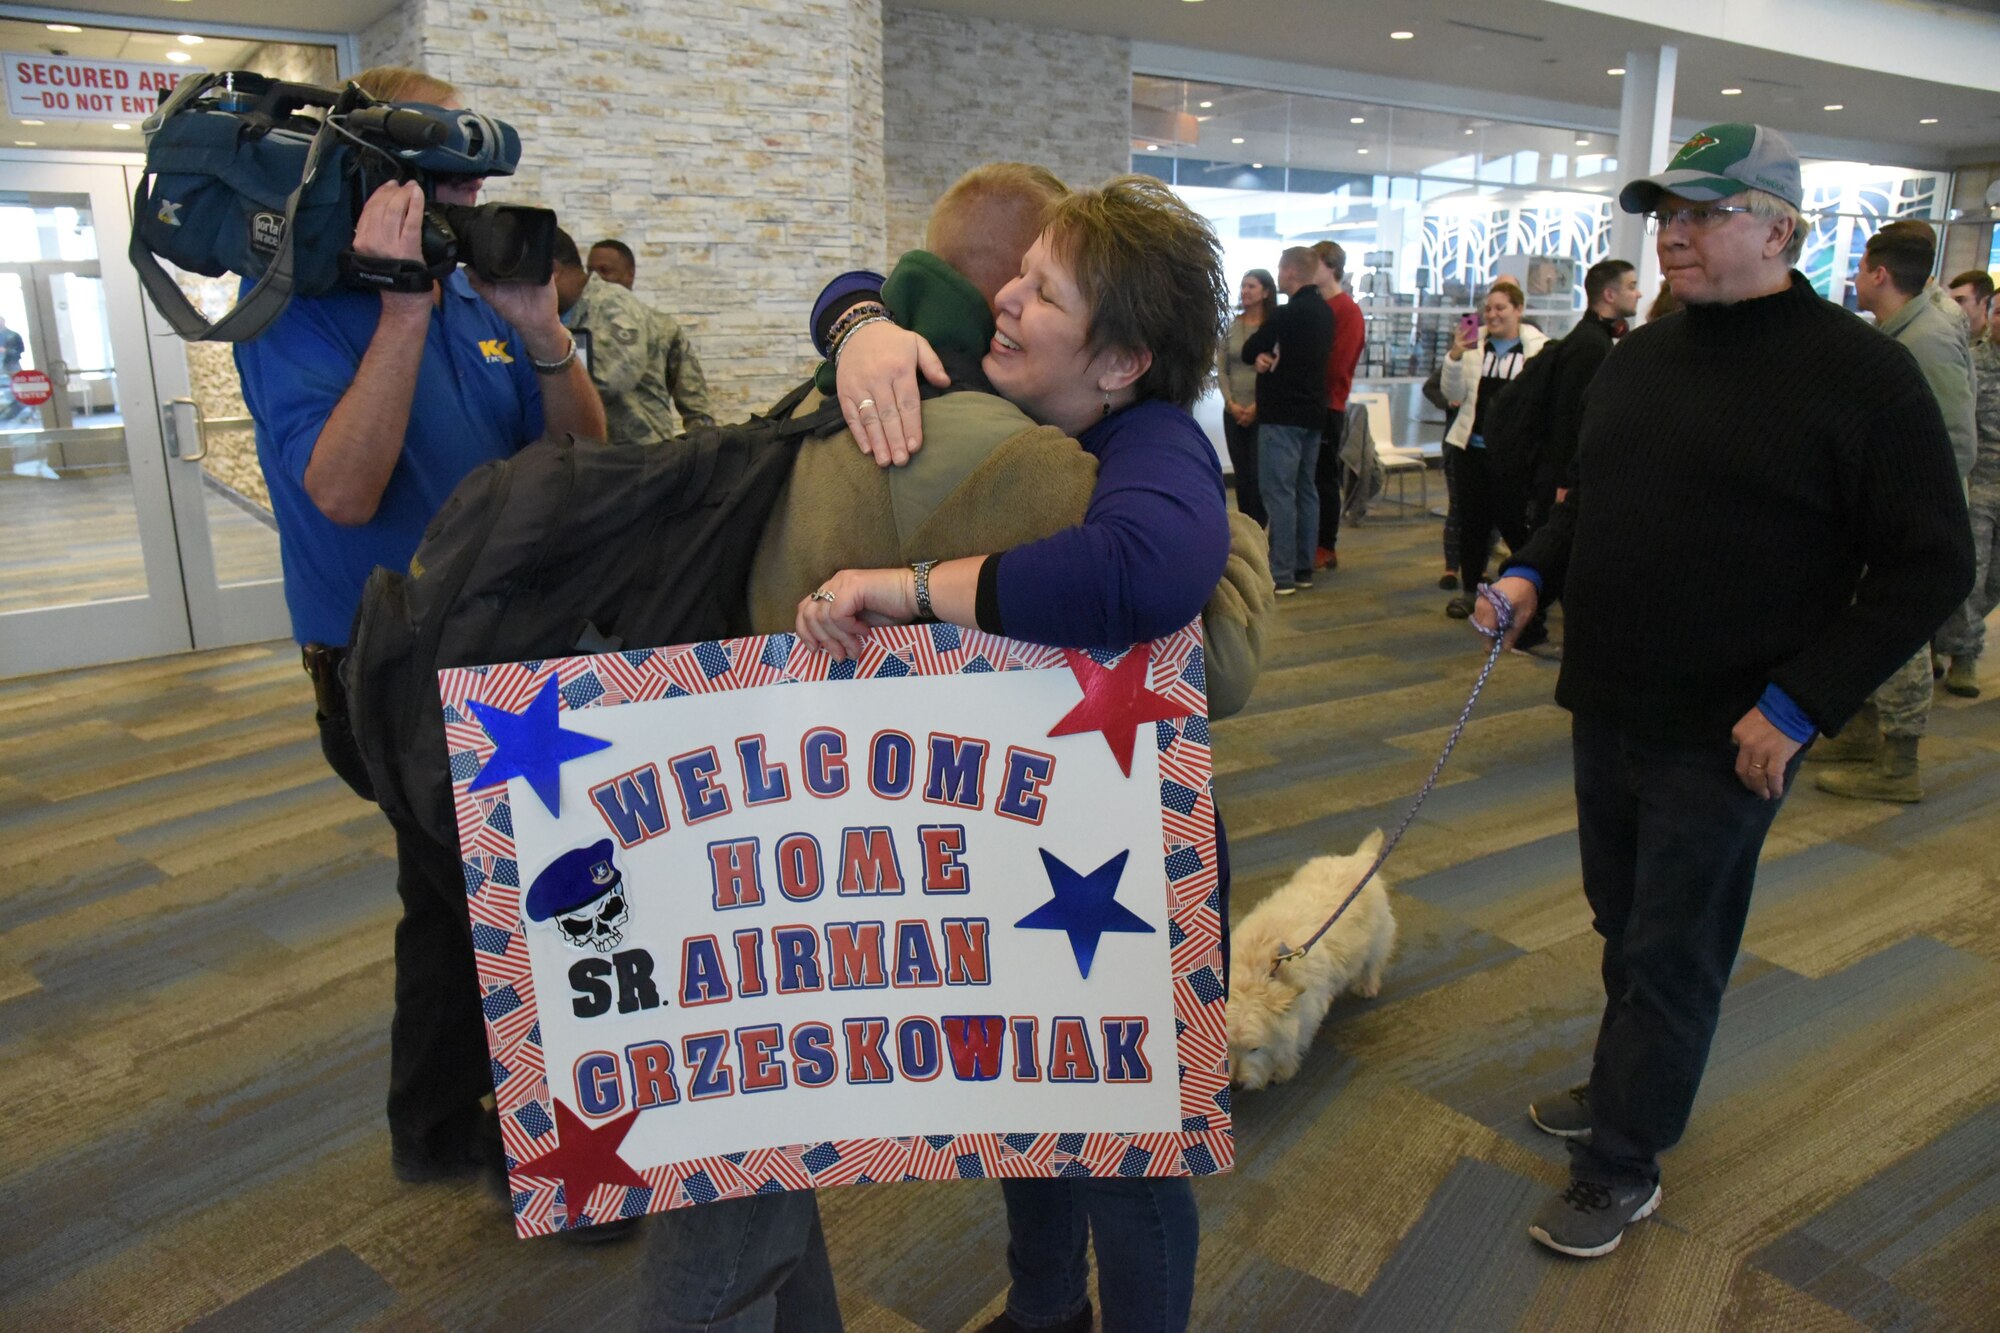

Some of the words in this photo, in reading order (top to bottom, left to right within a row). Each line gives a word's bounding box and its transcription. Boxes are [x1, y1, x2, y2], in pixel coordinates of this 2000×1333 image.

[17, 62, 129, 90] SECURED
[139, 71, 181, 92] ARE
[76, 94, 114, 112] NOT
[122, 96, 156, 114] ENT
[588, 726, 1056, 850] WELCOME
[707, 824, 970, 912] HOME
[568, 948, 669, 1018] SR.
[678, 917, 991, 1008] AIRMAN
[573, 1015, 1153, 1120] GRZESKOWIAK
